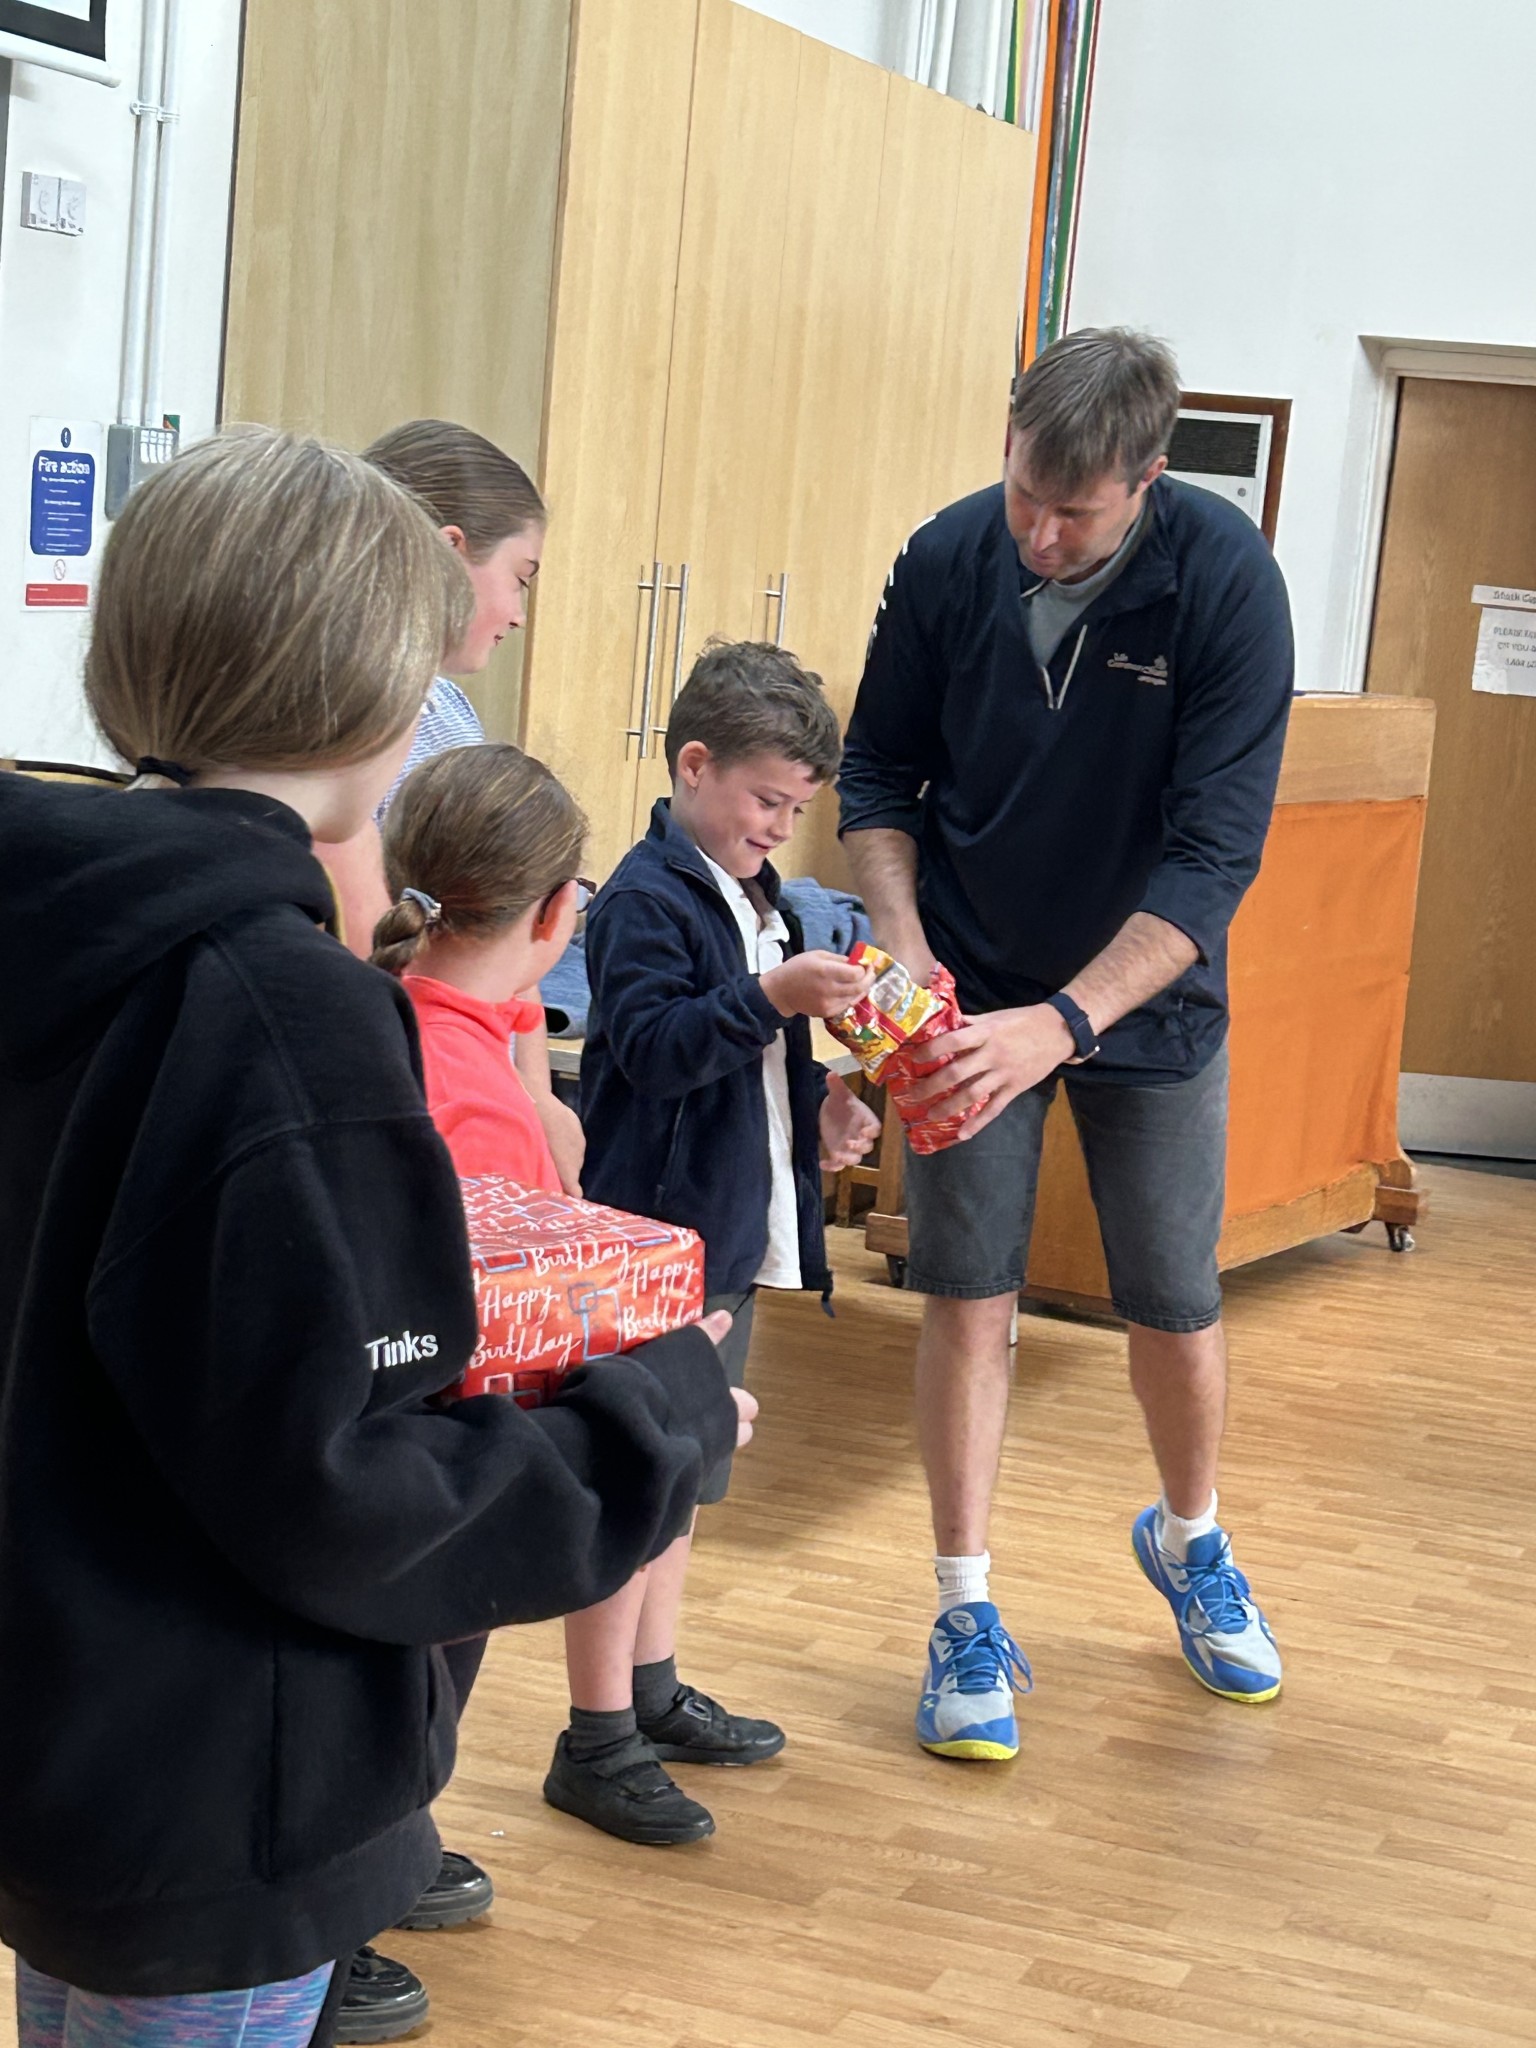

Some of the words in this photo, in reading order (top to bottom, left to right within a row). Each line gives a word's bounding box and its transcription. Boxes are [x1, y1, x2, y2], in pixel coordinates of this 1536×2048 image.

[39, 455, 58, 473] Fire
[60, 459, 90, 474] action
[530, 1239, 637, 1286] Birthday
[630, 1258, 700, 1299] Happy
[477, 1285, 561, 1328] Happy
[364, 1330, 439, 1371] Tinks
[469, 1322, 582, 1374] Birthday
